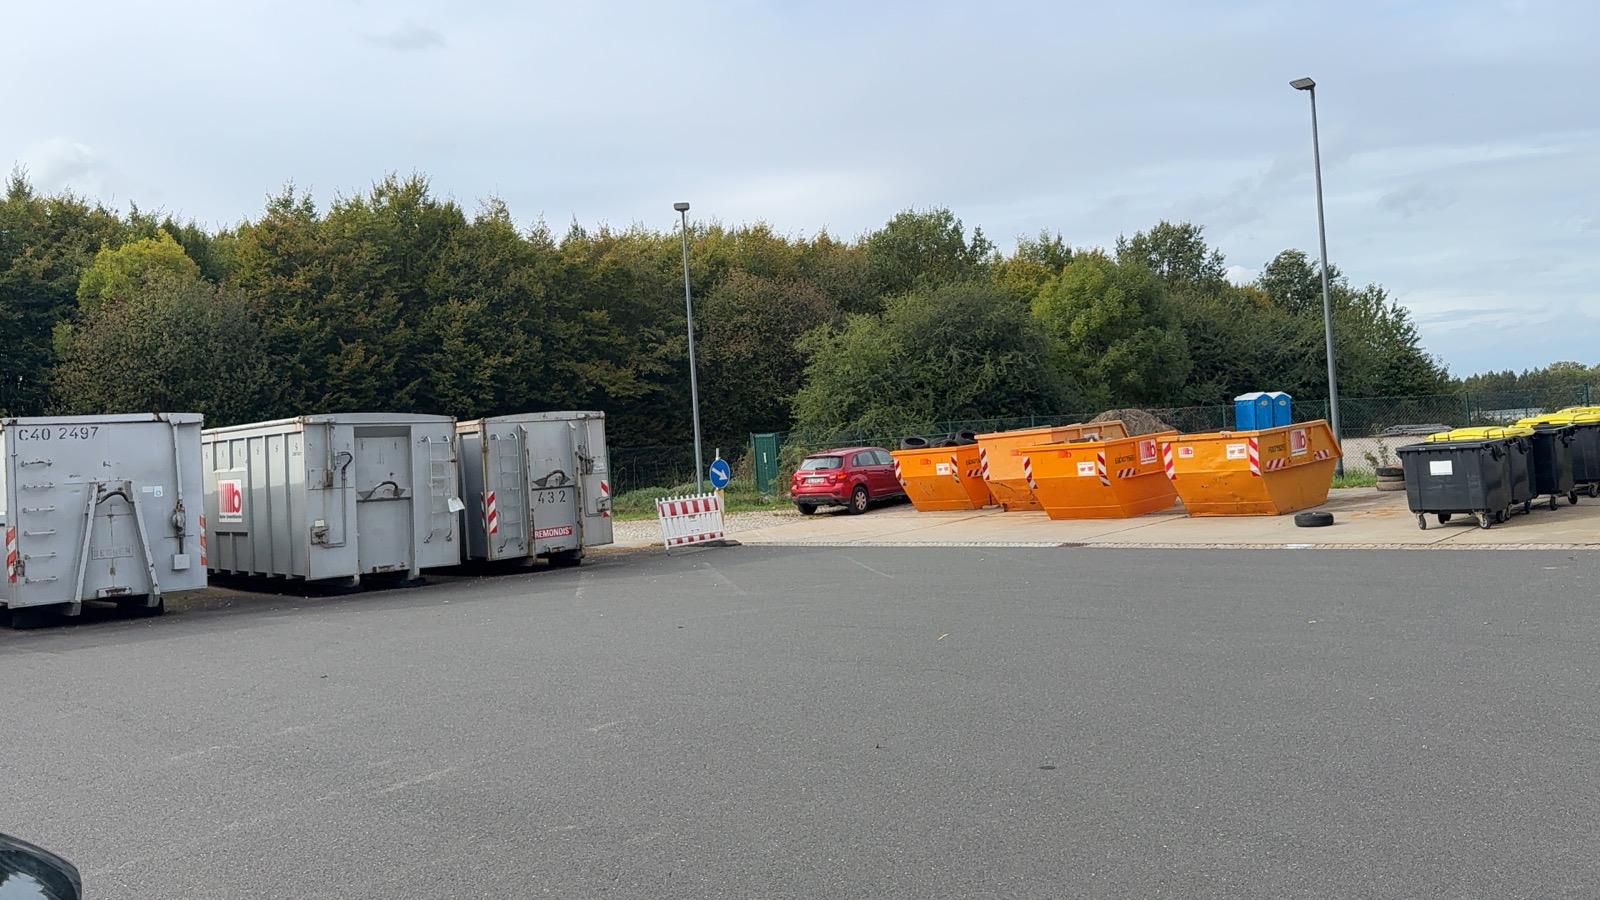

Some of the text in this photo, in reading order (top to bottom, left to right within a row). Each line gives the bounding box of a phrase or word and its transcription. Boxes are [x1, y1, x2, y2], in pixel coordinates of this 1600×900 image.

[18, 426, 99, 441] C40 2497
[537, 490, 566, 504] 432
[534, 527, 570, 538] REMONDIS
